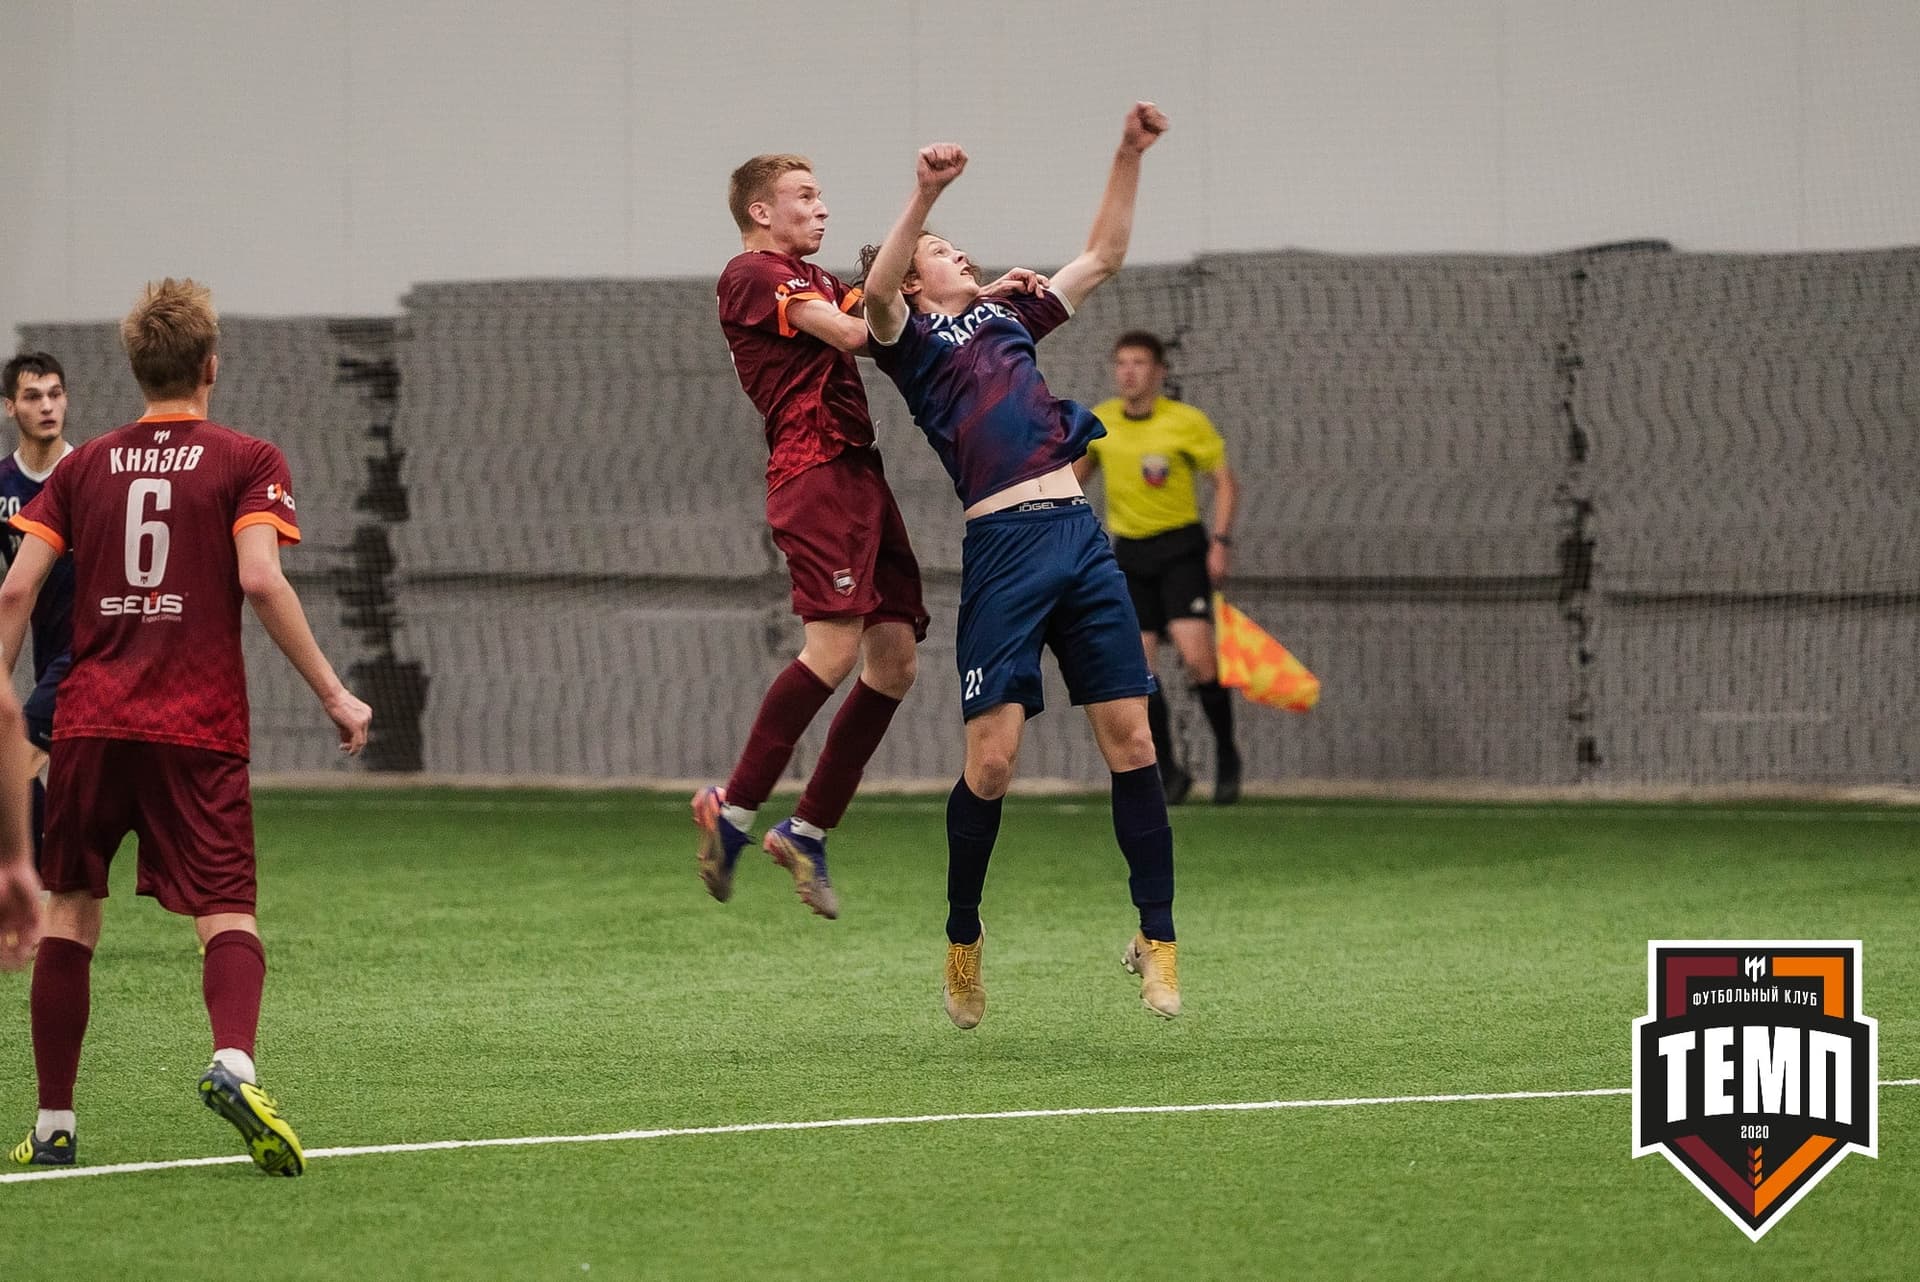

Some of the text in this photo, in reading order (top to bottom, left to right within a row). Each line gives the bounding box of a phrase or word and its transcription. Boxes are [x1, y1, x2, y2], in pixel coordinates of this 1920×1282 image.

[110, 445, 204, 475] КНЯЗЕВ
[124, 478, 172, 588] 6
[965, 667, 984, 701] 21
